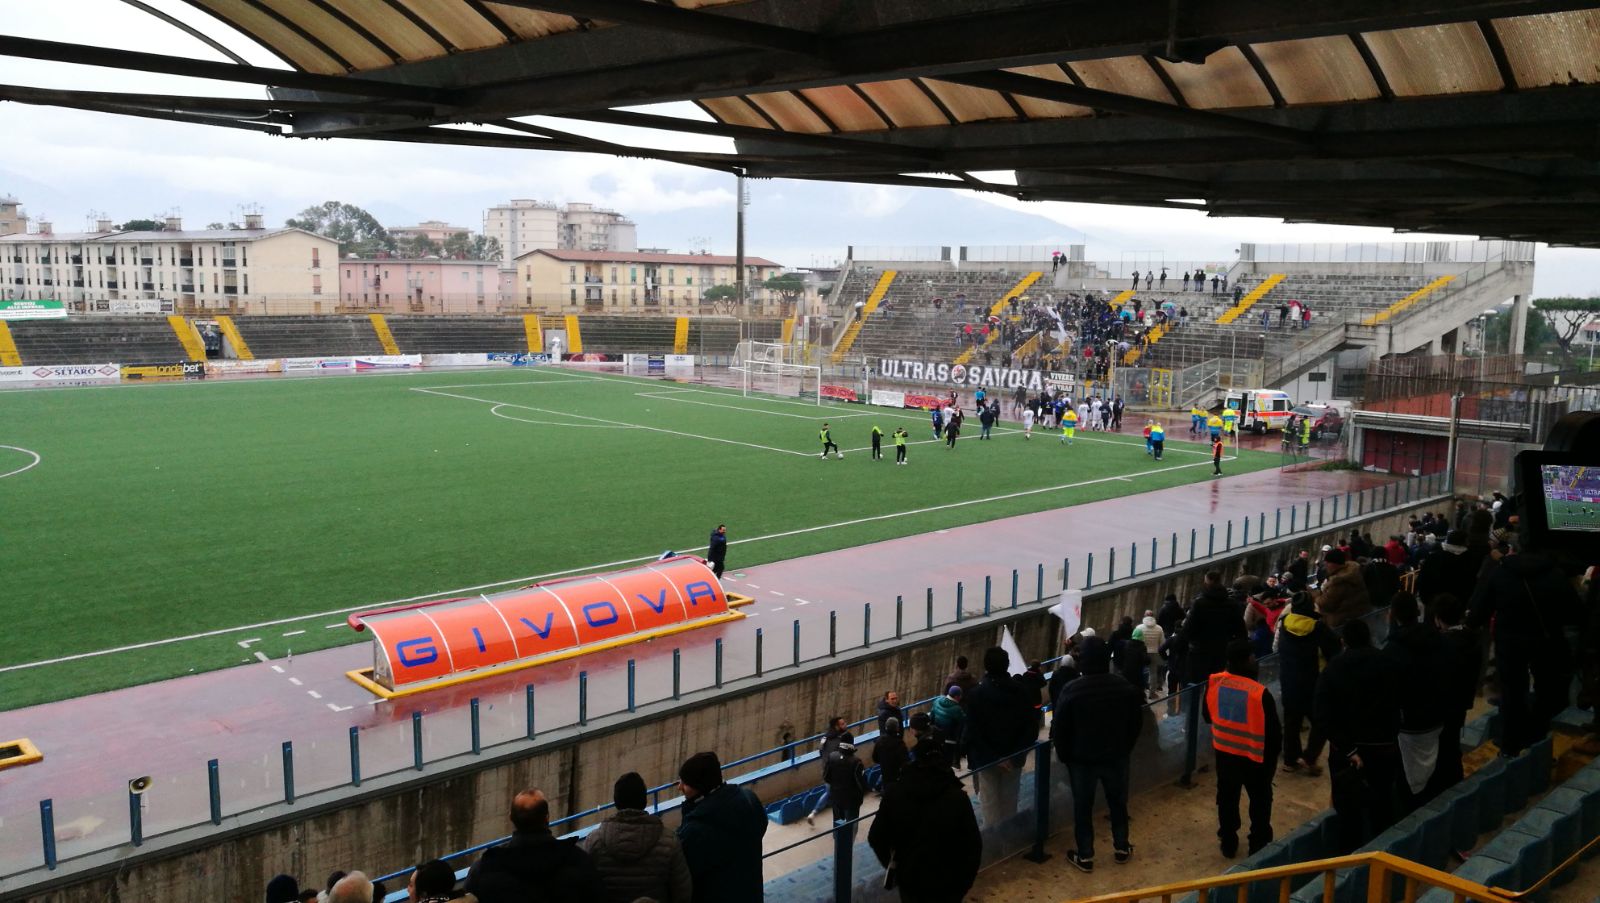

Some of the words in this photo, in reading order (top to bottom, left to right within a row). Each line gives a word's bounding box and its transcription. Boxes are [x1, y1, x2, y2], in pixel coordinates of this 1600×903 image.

[54, 367, 97, 376] SETARO
[158, 363, 200, 373] ondabet
[881, 359, 949, 382] ULTRAS
[969, 366, 1042, 390] SAVOIA
[1050, 372, 1075, 381] VIVERE
[396, 581, 716, 668] GIVOVA
